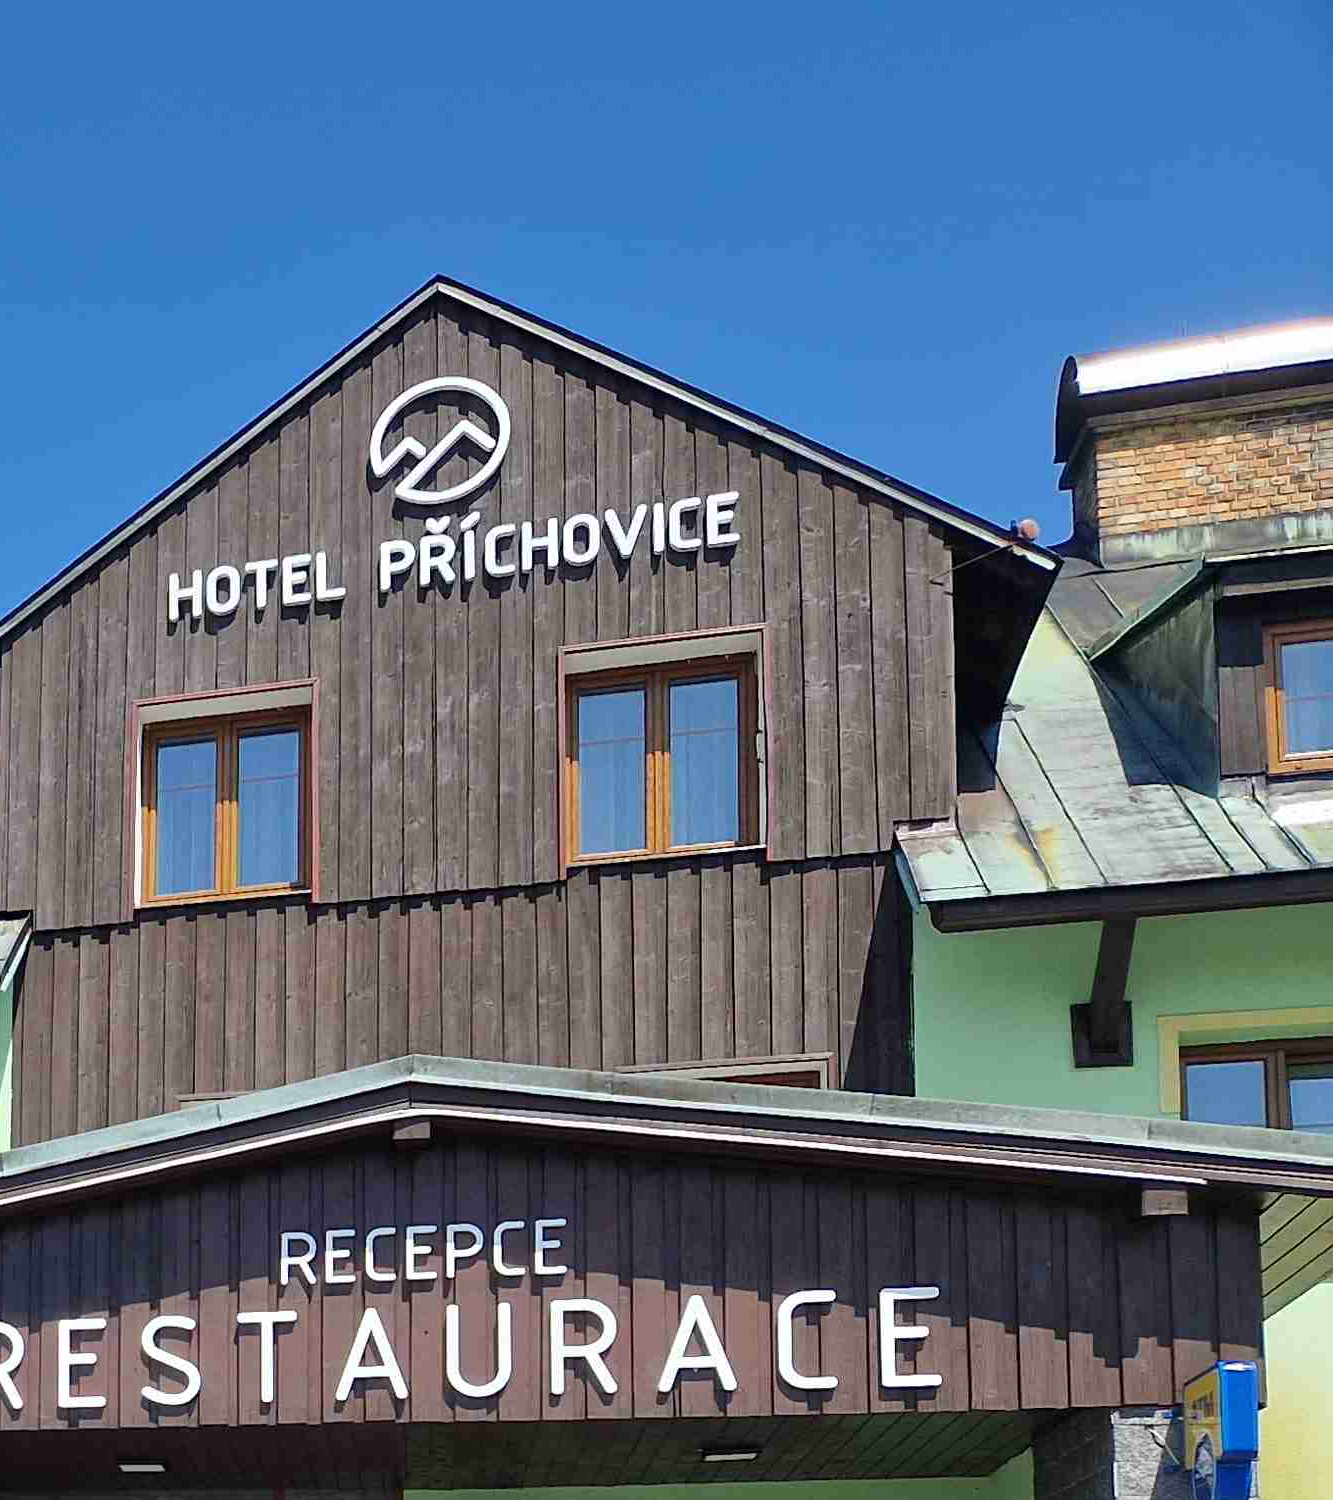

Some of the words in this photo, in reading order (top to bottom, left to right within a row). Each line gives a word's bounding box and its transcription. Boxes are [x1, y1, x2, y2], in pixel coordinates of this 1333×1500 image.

[168, 551, 346, 623] HOTEL
[379, 490, 741, 593] PŘÍCHOVICE
[279, 1217, 568, 1286] RECEPCE
